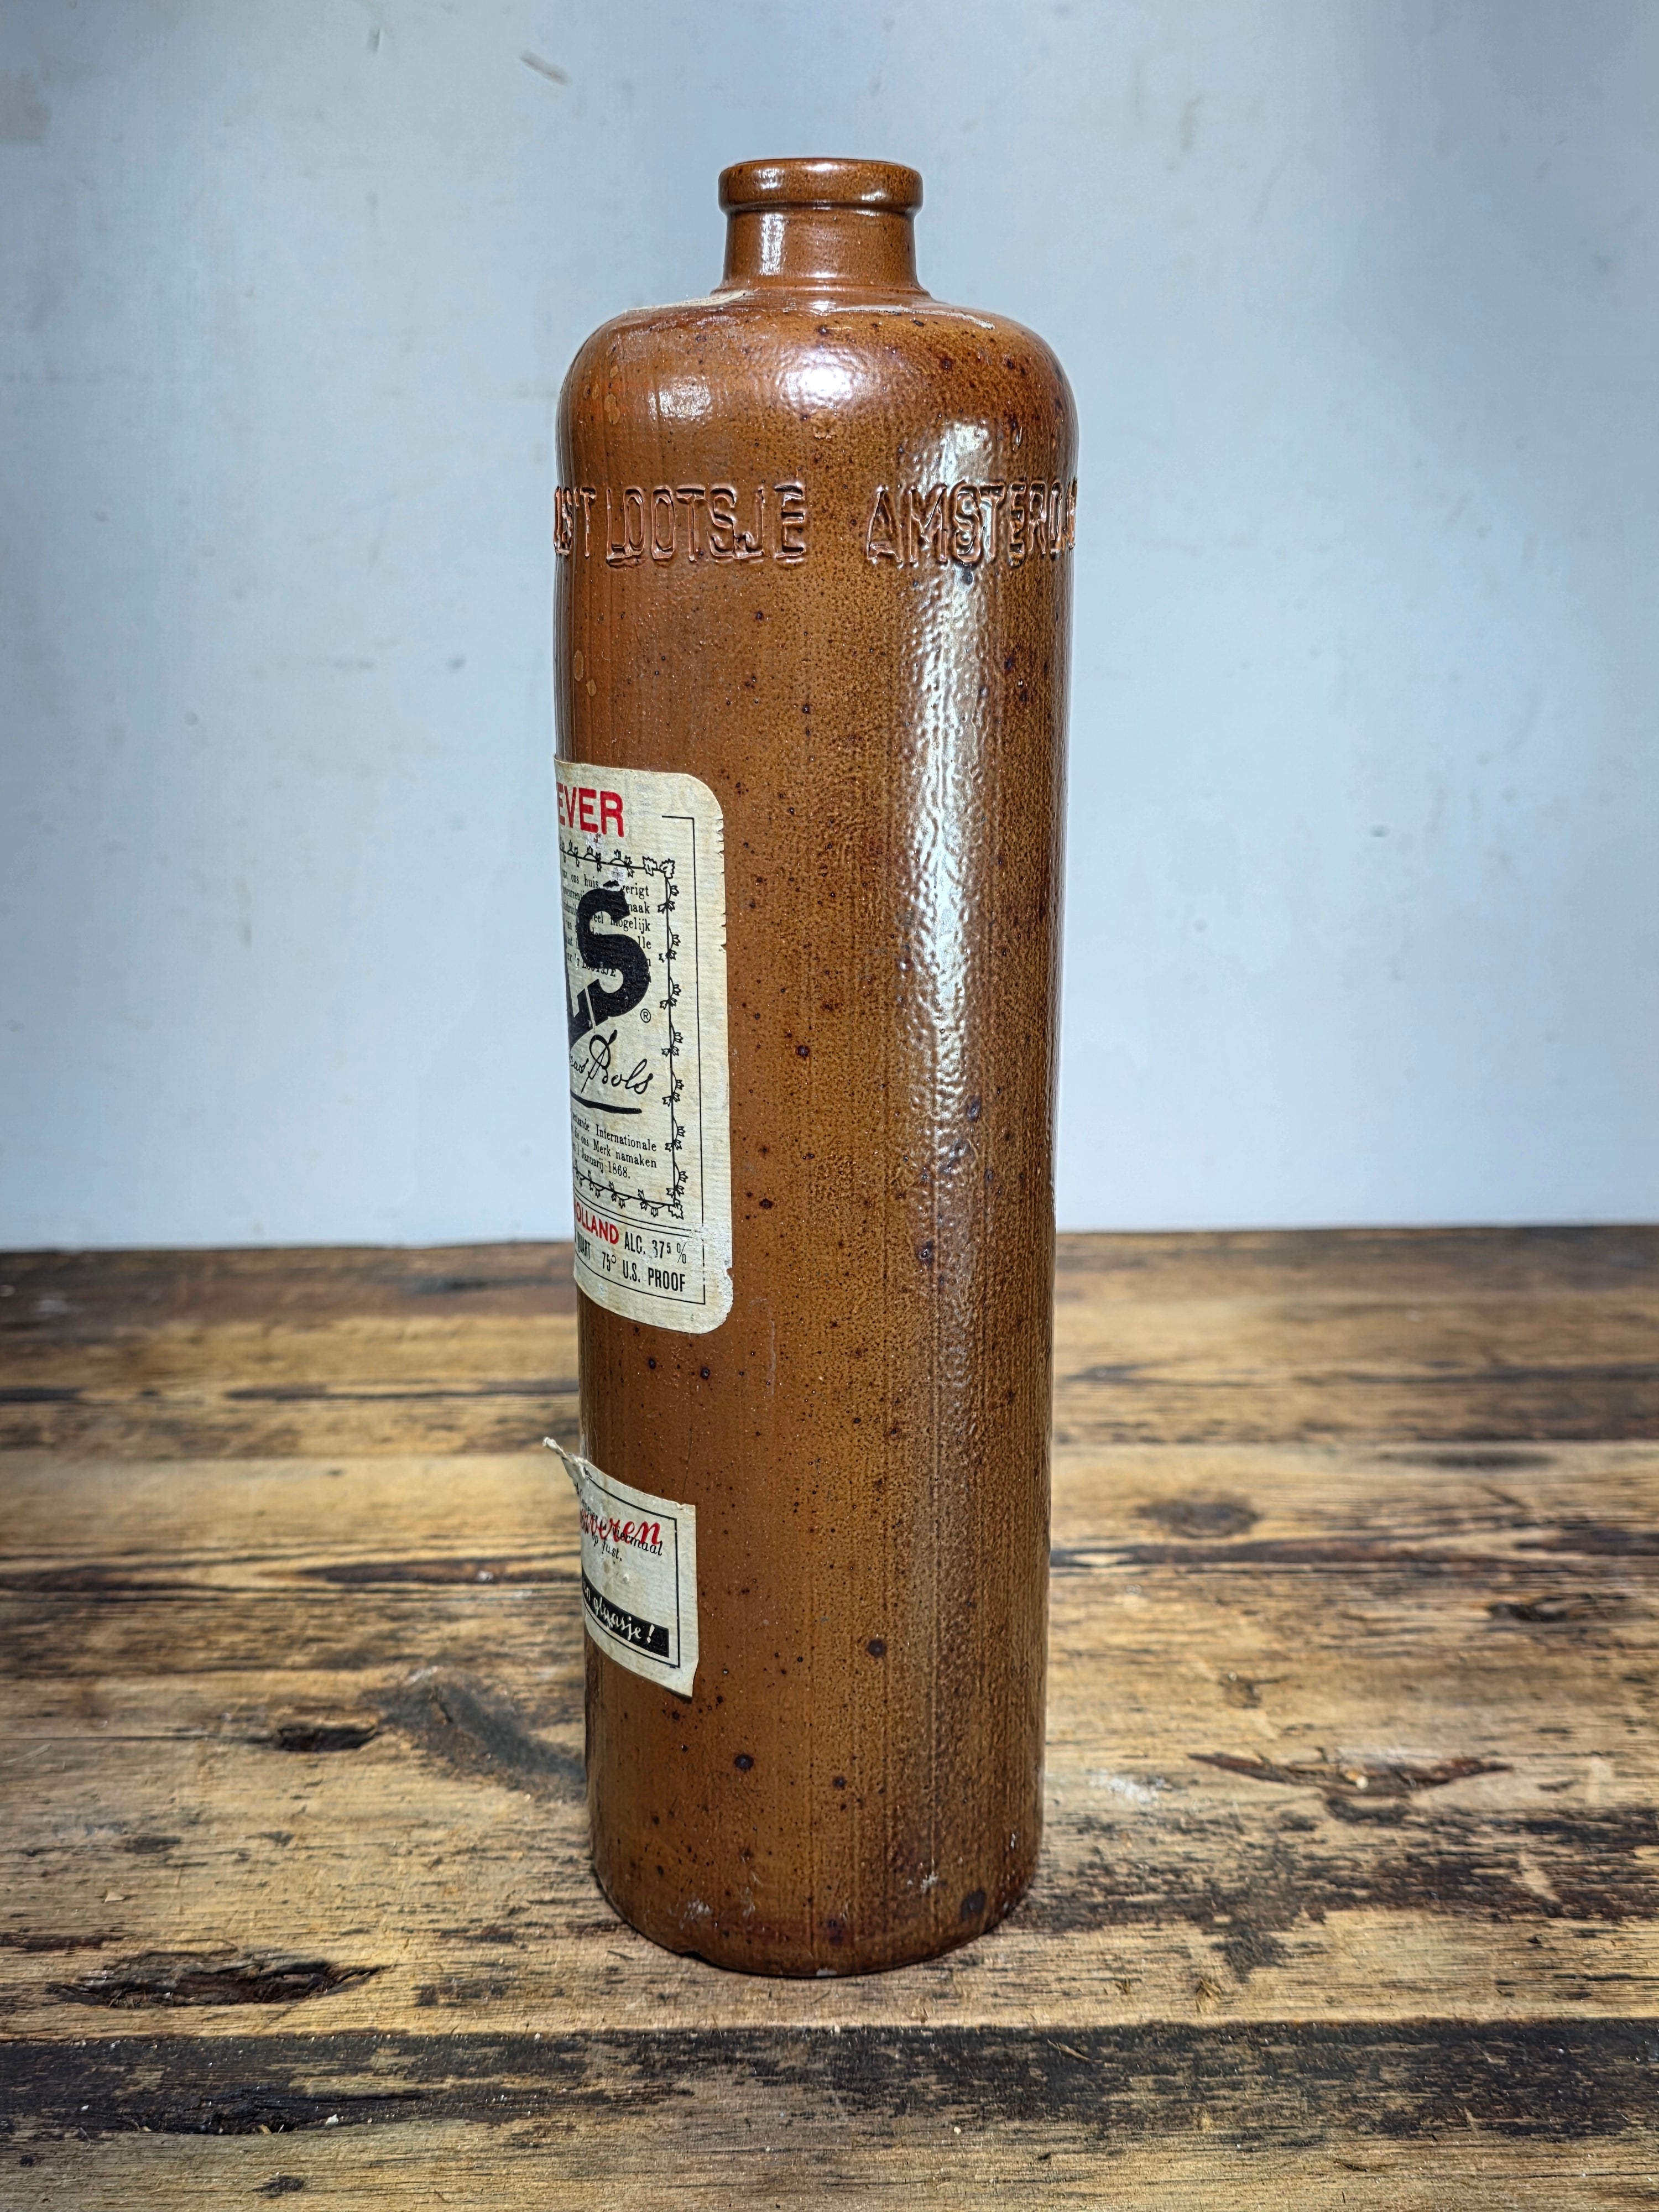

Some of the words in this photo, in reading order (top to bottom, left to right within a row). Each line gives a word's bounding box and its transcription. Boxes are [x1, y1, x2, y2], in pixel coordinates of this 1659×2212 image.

[606, 481, 807, 564] LOOTSJE
[593, 1138, 611, 1157] Merk
[615, 1149, 658, 1168] namaken
[596, 1124, 657, 1151] Internationale
[608, 1161, 631, 1179] 1868.
[574, 1200, 619, 1245] OLLAND
[624, 1231, 646, 1255] ALC.
[623, 1260, 641, 1283] U.S.
[648, 1267, 686, 1292] PROOF
